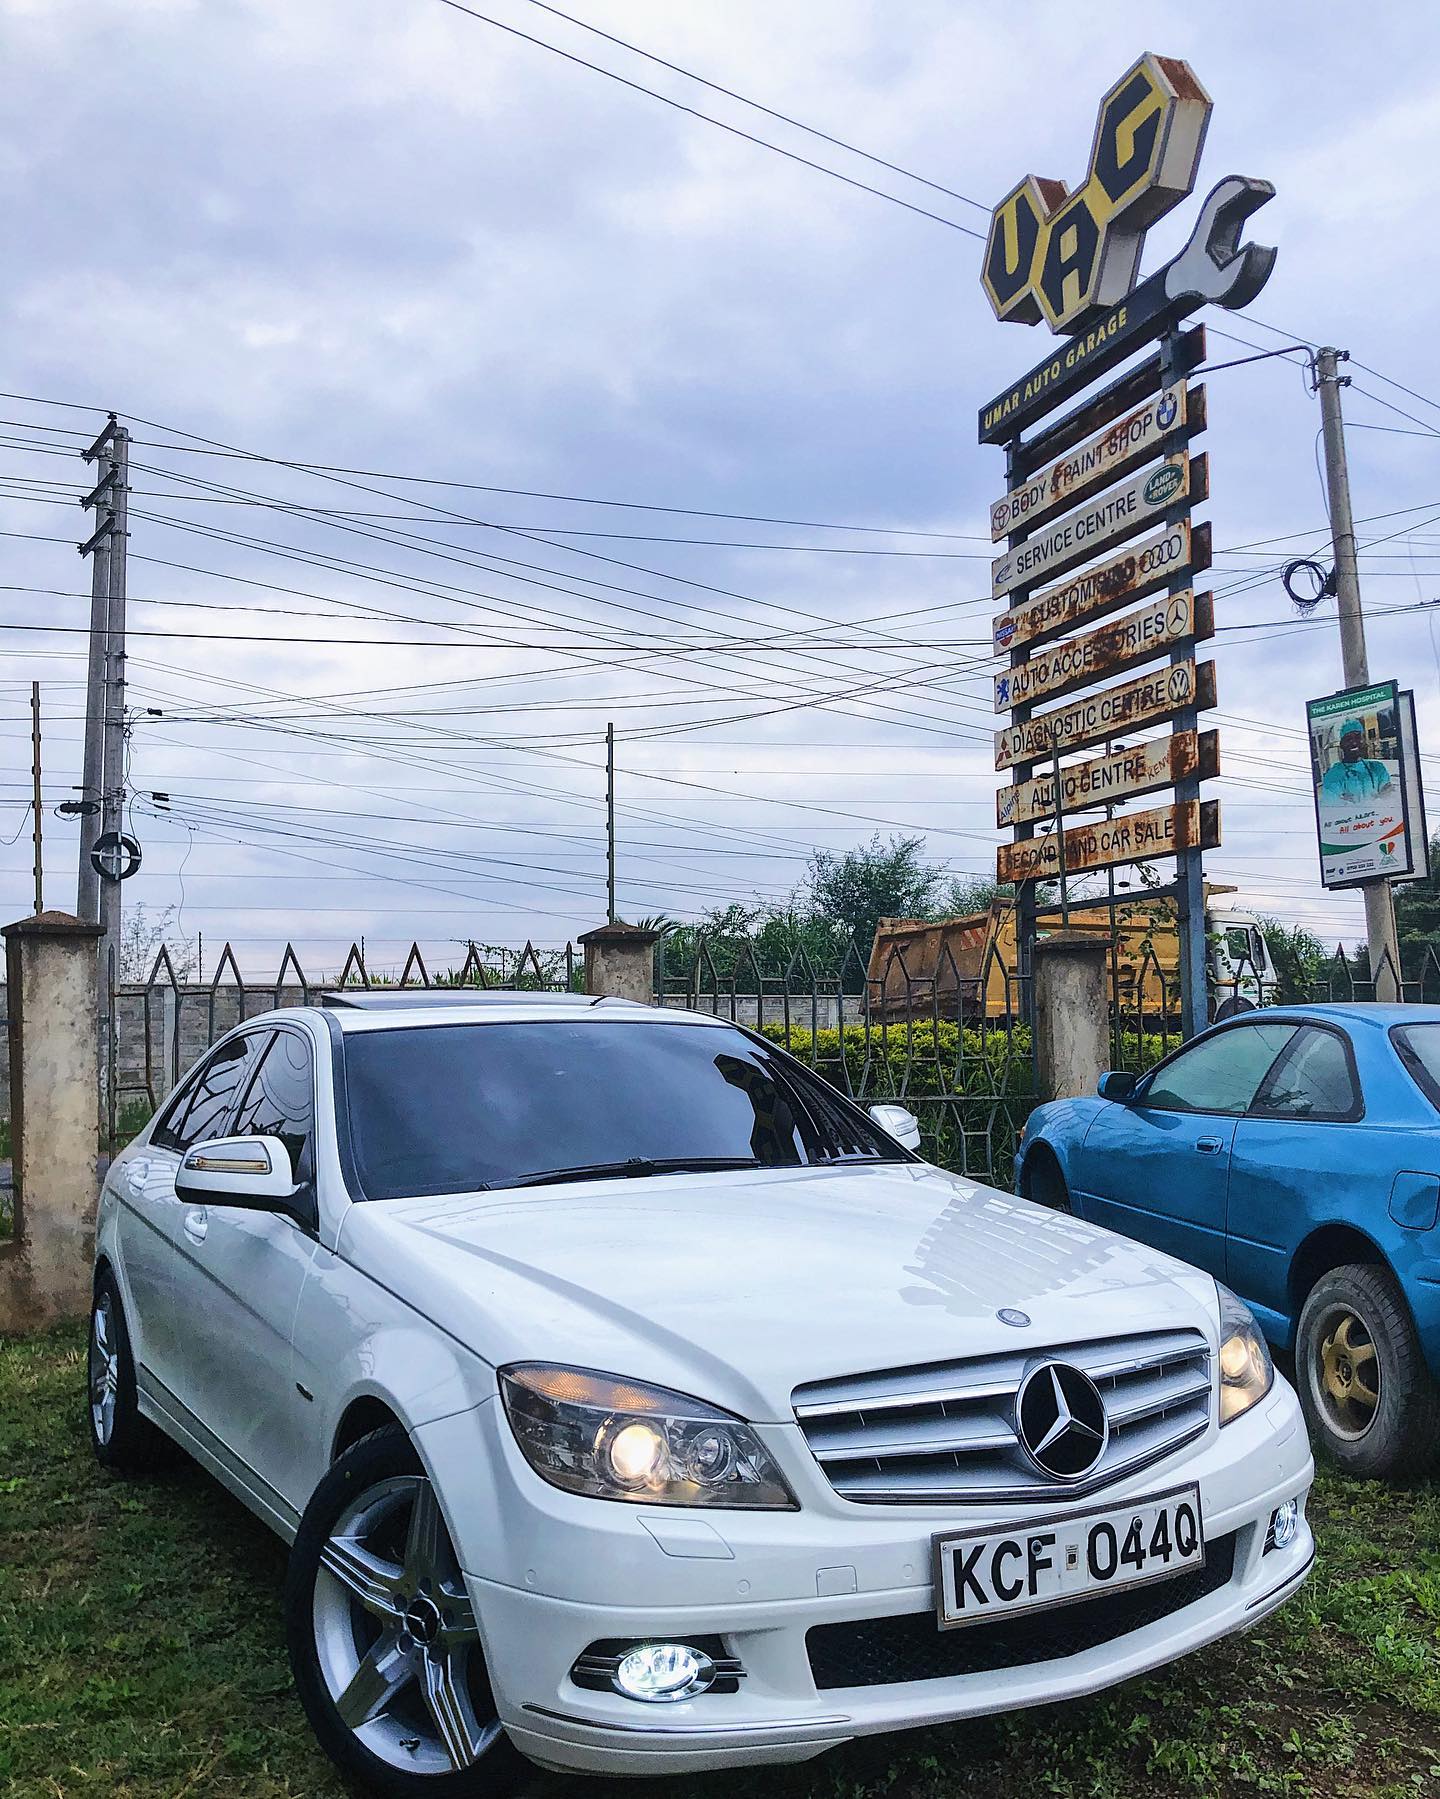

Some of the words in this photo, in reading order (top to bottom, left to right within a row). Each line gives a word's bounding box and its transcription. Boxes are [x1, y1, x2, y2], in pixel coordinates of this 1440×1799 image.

[985, 392, 1019, 430] UMAR
[1024, 361, 1060, 401] AUTO
[1066, 307, 1127, 368] GARAGE
[1012, 482, 1046, 519] BODY
[1063, 445, 1106, 486] PAINT
[1108, 413, 1152, 456] SHOP
[1150, 472, 1171, 491] LAND
[1152, 478, 1180, 499] ROVER
[1017, 528, 1073, 574] SERVICE
[1076, 490, 1137, 540] CENTRE
[1012, 664, 1049, 697] AUTO
[1052, 612, 1165, 679] ACCEORIES
[1312, 707, 1326, 715] THE
[1327, 701, 1350, 711] KAREN
[1351, 691, 1386, 704] HOSPITAL
[1013, 707, 1097, 753] DIAGNOSTIC
[1001, 789, 1021, 820] Alpine
[1032, 778, 1076, 811] AUDIO
[1080, 755, 1145, 793] CENTRE
[1101, 828, 1130, 850] CAR
[1134, 818, 1174, 845] SALE
[1353, 820, 1375, 831] about
[952, 1533, 1056, 1609] KCF
[1087, 1502, 1198, 1581] 044Q
